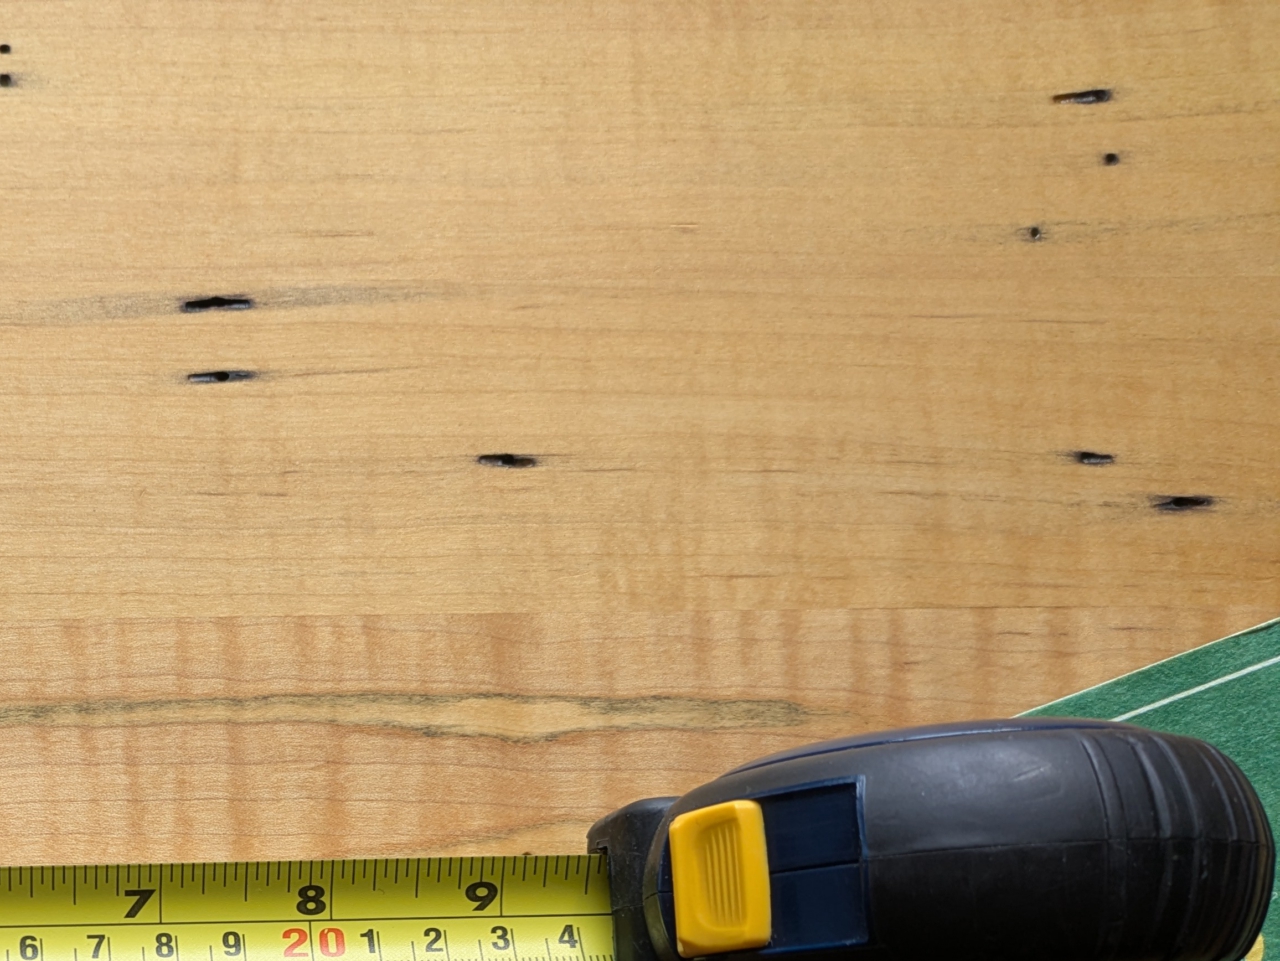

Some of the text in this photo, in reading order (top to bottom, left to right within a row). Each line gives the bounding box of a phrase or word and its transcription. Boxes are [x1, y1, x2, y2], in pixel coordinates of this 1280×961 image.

[123, 889, 158, 918] 7
[296, 885, 327, 915] 8
[464, 882, 499, 911] 9
[19, 936, 39, 961] 6
[86, 935, 106, 959] 7
[155, 933, 175, 958] 8
[222, 932, 241, 956] 9
[281, 928, 346, 958] 20
[360, 930, 377, 954] 1
[423, 929, 444, 953] 2
[491, 926, 510, 950] 3
[558, 925, 578, 949] 4
